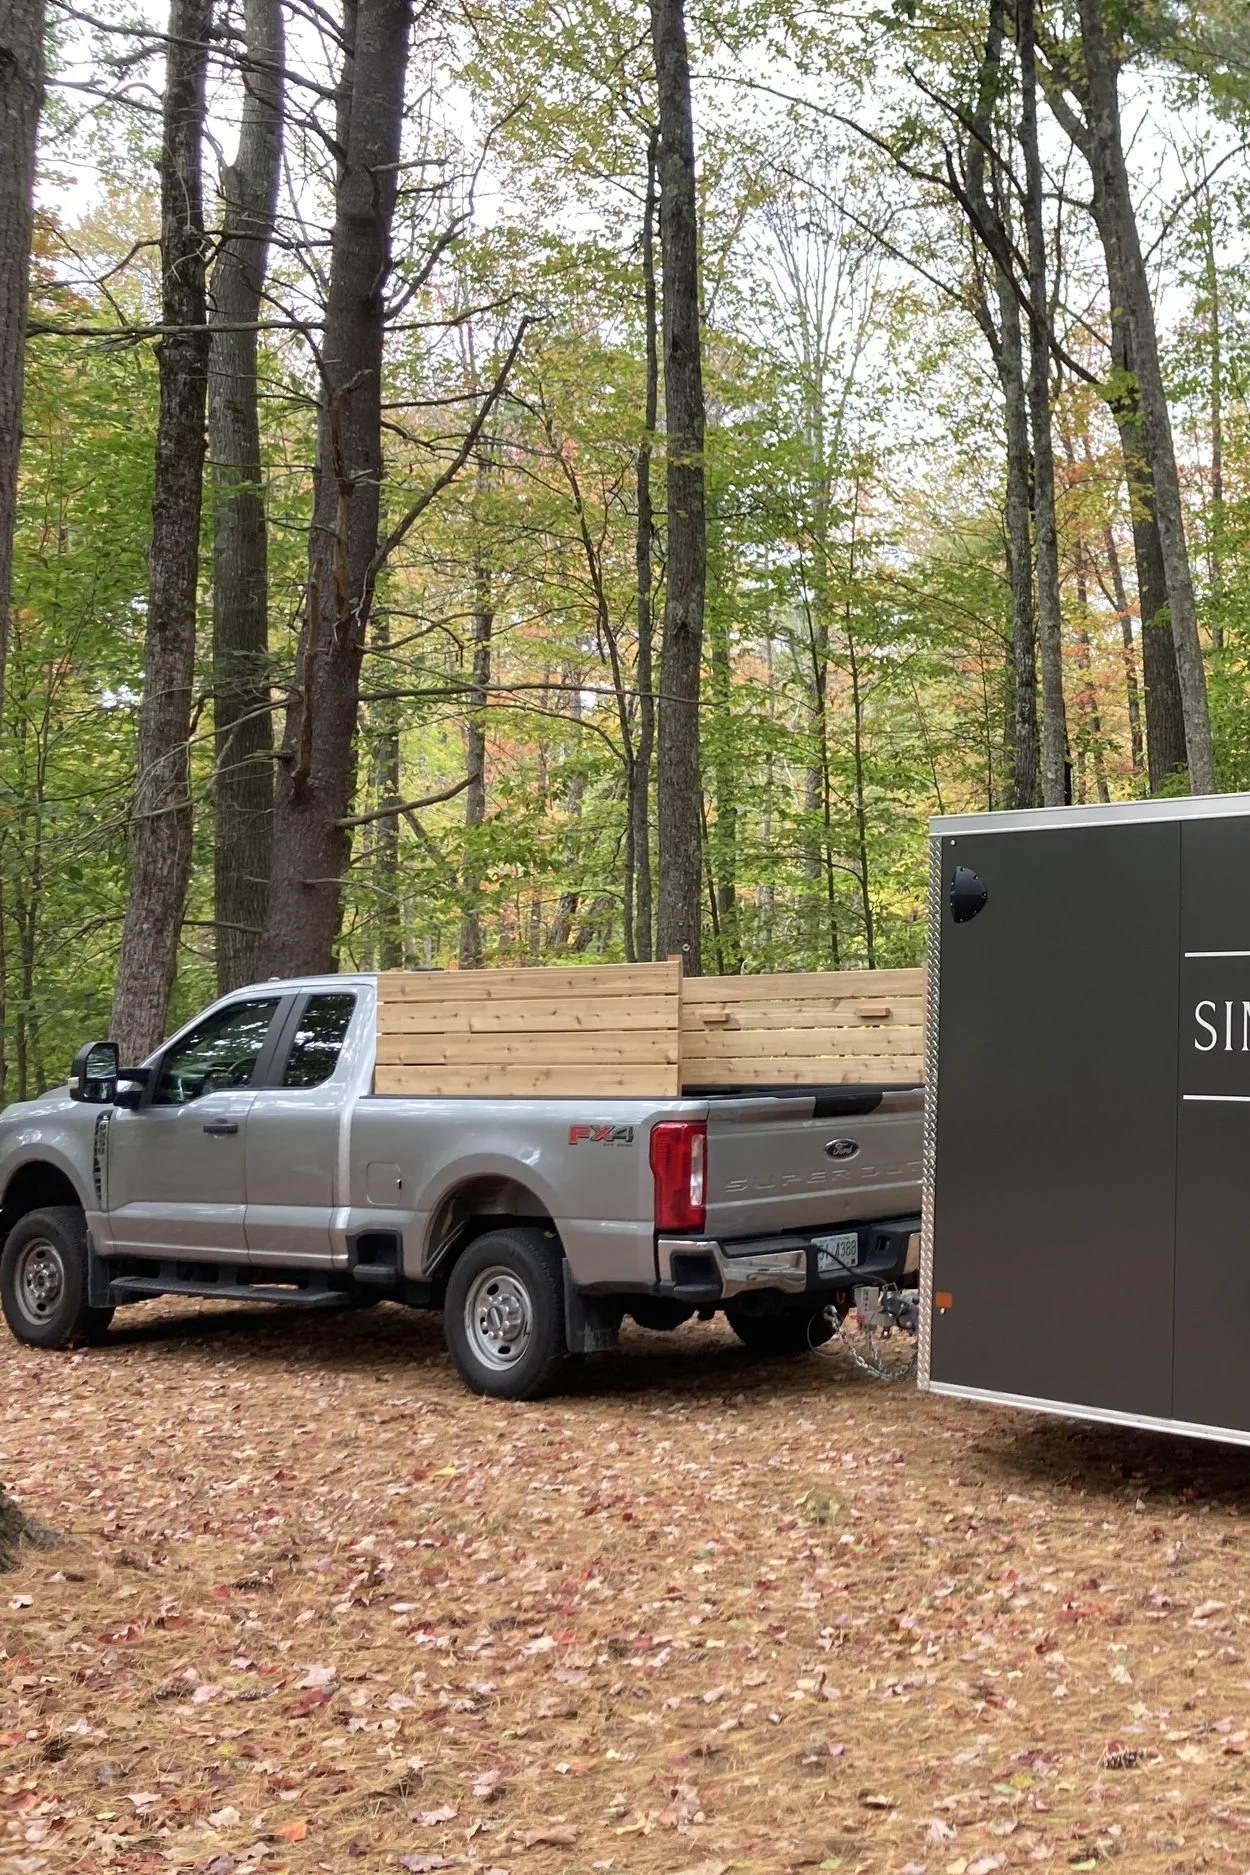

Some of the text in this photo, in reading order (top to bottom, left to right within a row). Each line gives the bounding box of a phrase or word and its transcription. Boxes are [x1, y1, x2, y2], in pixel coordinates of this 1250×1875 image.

[568, 1124, 634, 1146] FX4
[832, 1142, 854, 1155] Ford
[725, 1160, 923, 1193] SUPER DUT
